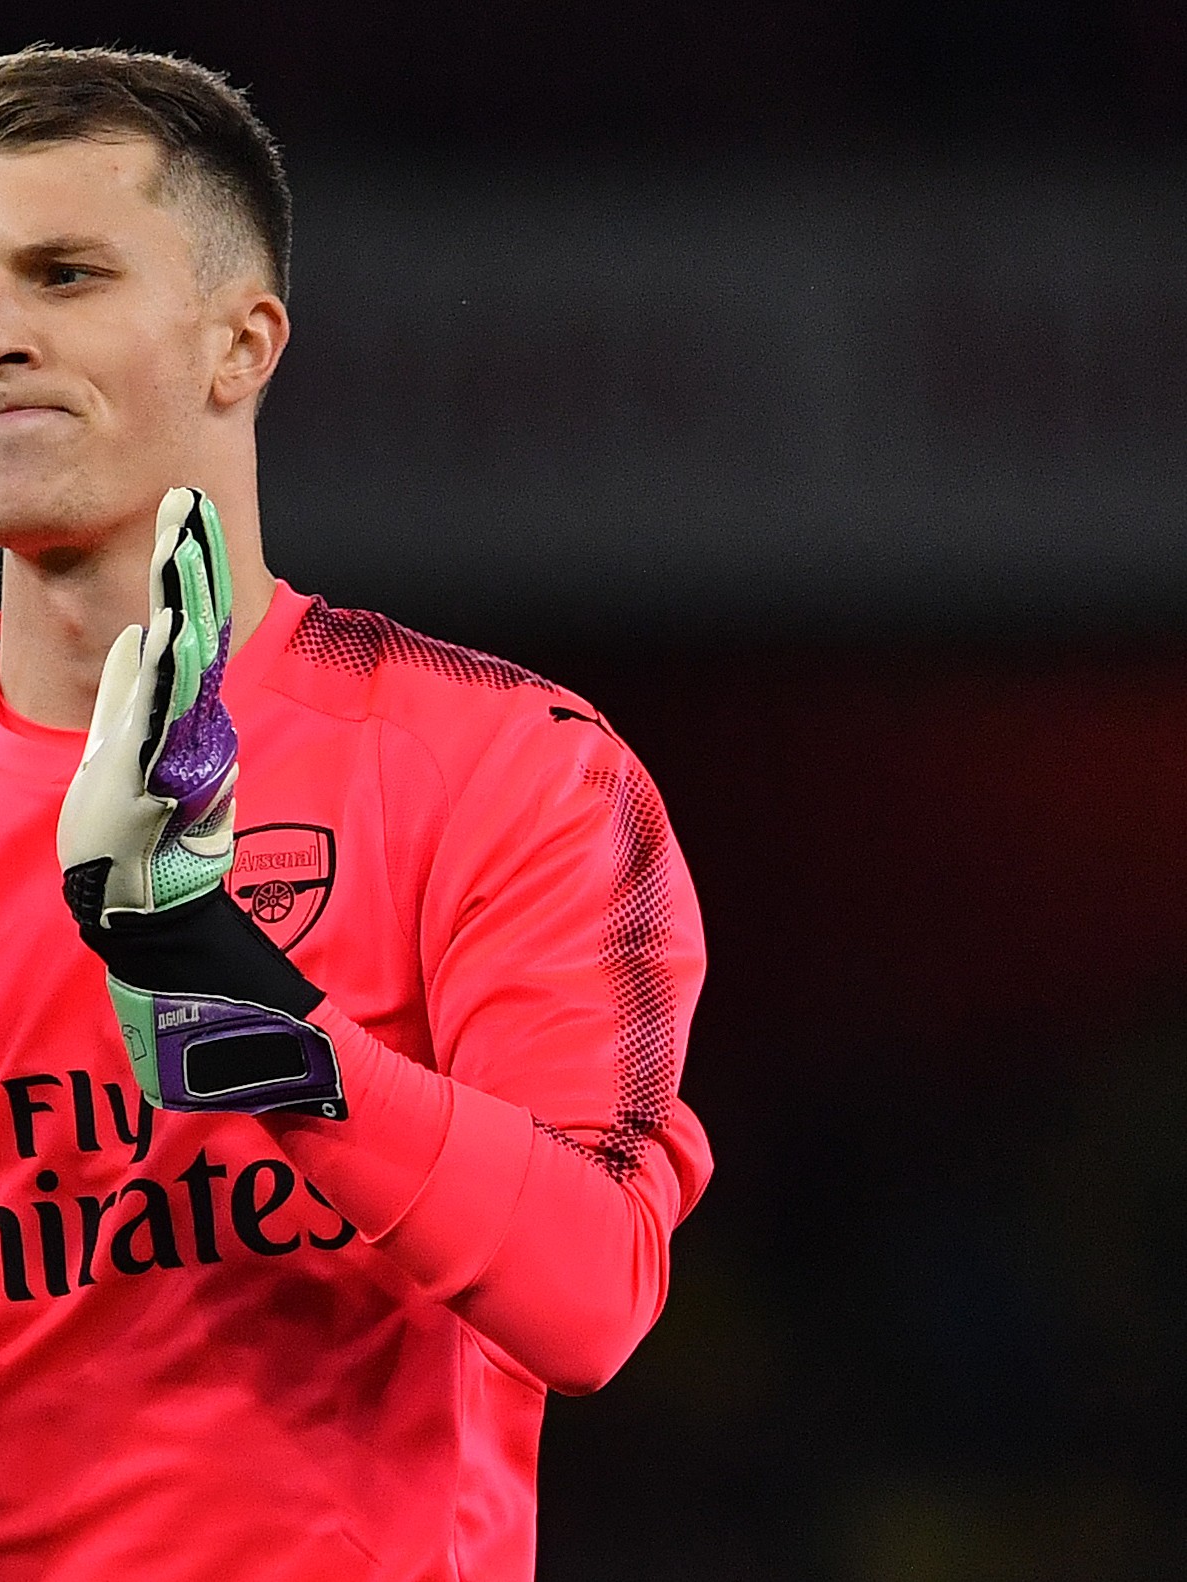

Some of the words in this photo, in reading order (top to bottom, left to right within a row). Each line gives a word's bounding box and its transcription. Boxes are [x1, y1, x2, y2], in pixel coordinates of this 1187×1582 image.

[235, 845, 317, 873] Arsenal
[158, 1003, 201, 1030] AGUILA
[2, 1069, 154, 1164] Fly
